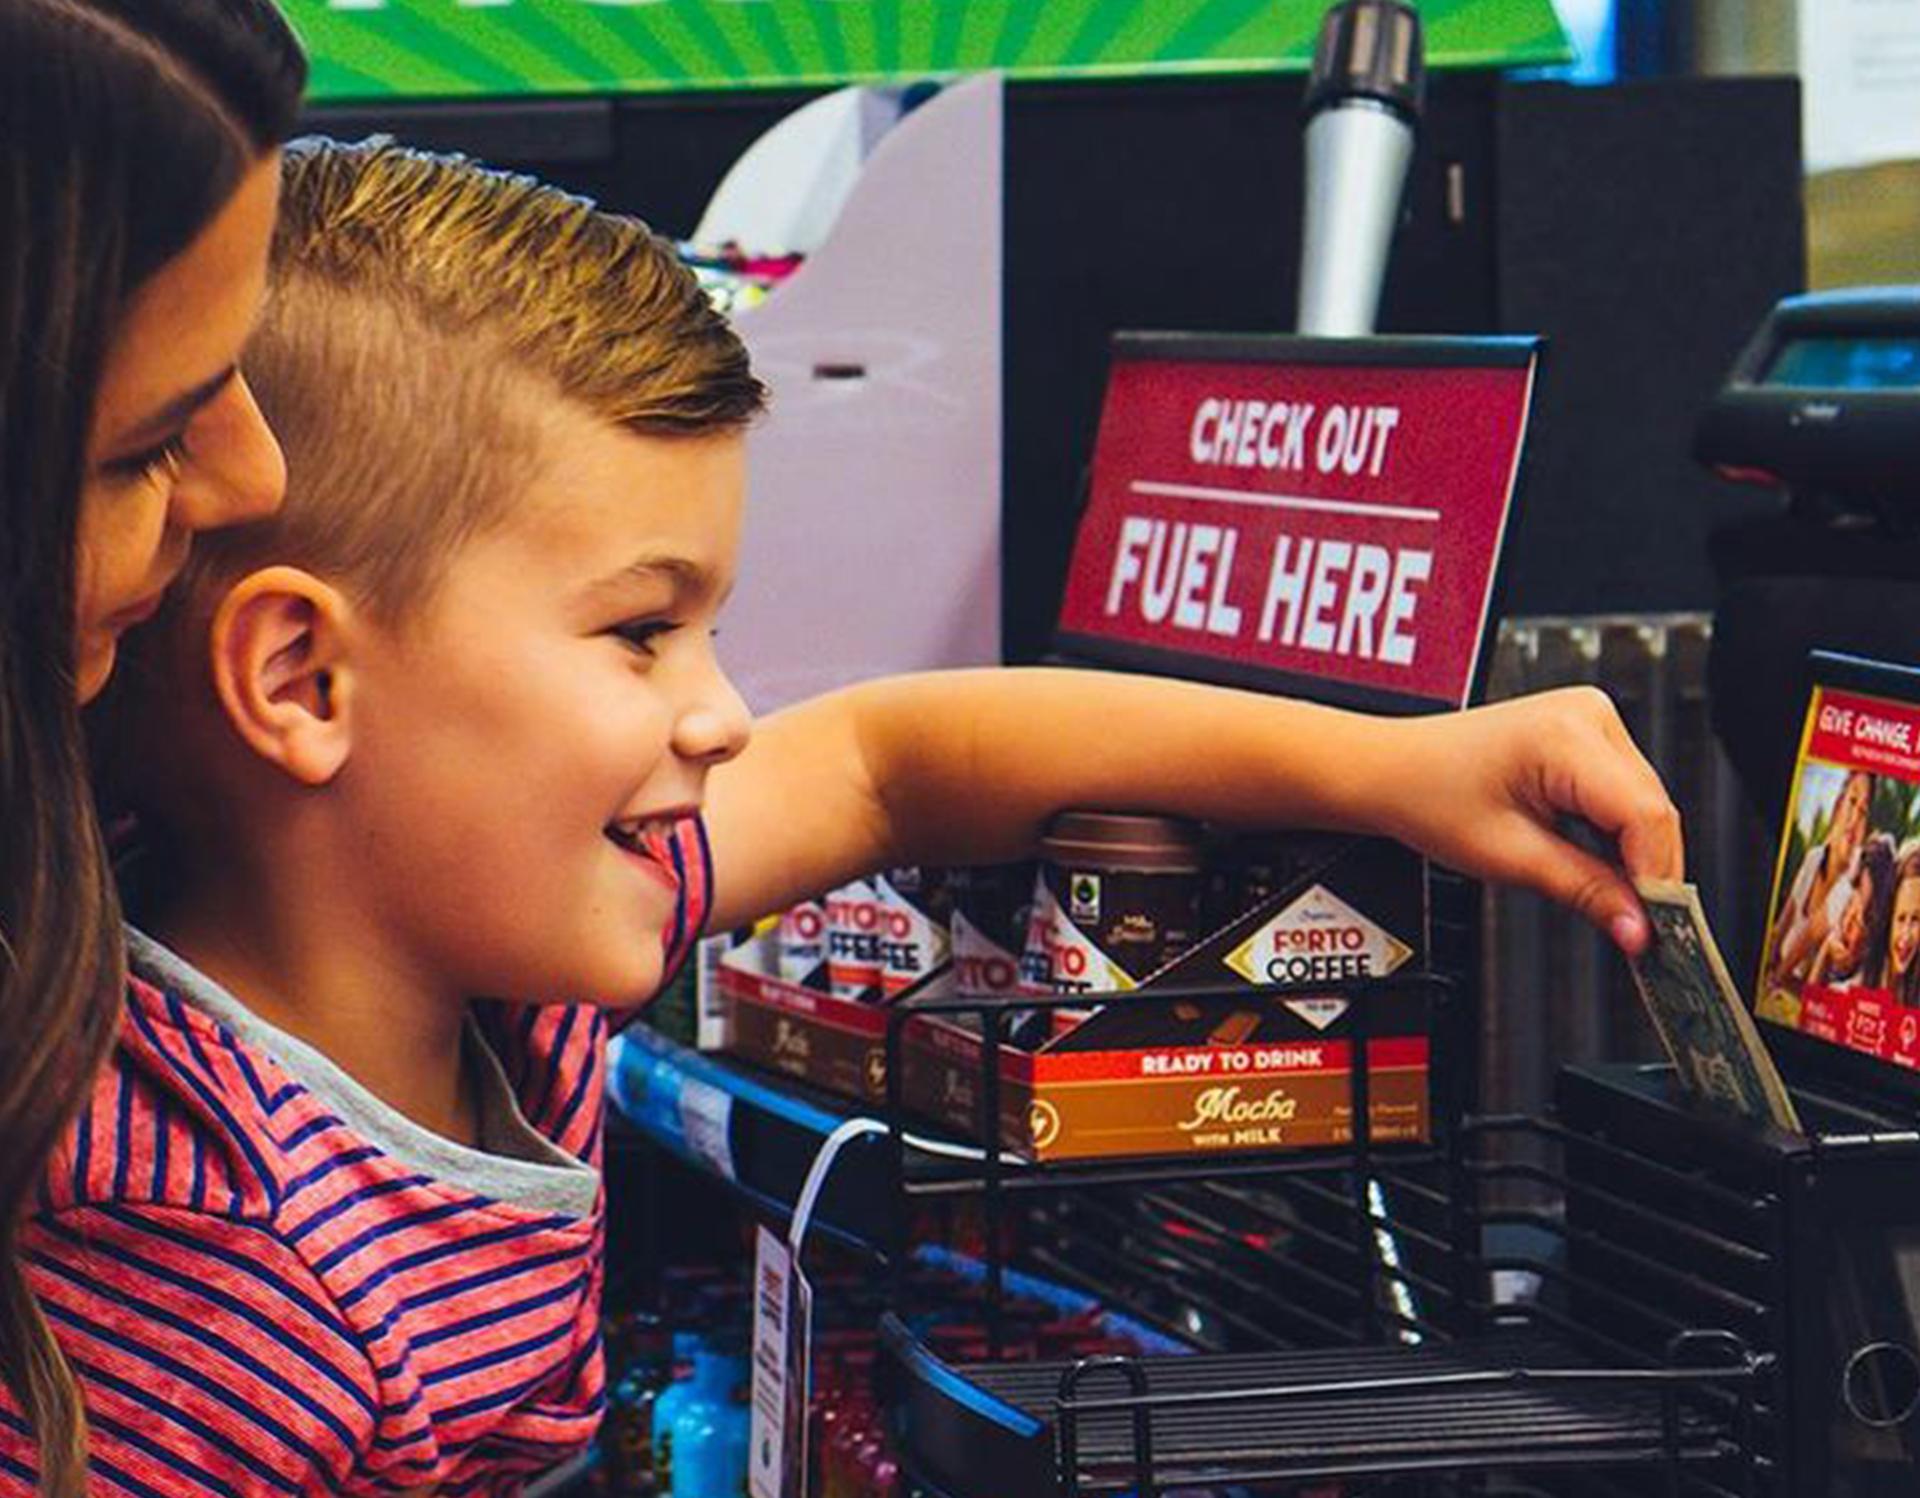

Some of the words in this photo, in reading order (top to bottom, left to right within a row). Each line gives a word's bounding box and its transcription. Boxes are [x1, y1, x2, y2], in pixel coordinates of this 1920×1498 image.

[1189, 398, 1314, 471] CHECK
[1316, 404, 1400, 477] OUT
[1105, 515, 1242, 638] FUEL
[1257, 535, 1434, 667] HERE
[1272, 926, 1366, 954] FORTO
[1266, 953, 1371, 984] COFFEE
[1141, 1048, 1212, 1075] READY
[1217, 1051, 1249, 1072] TO
[1254, 1047, 1323, 1070] DRINK
[1178, 1086, 1297, 1130] Mocha
[1233, 1128, 1281, 1144] MILK
